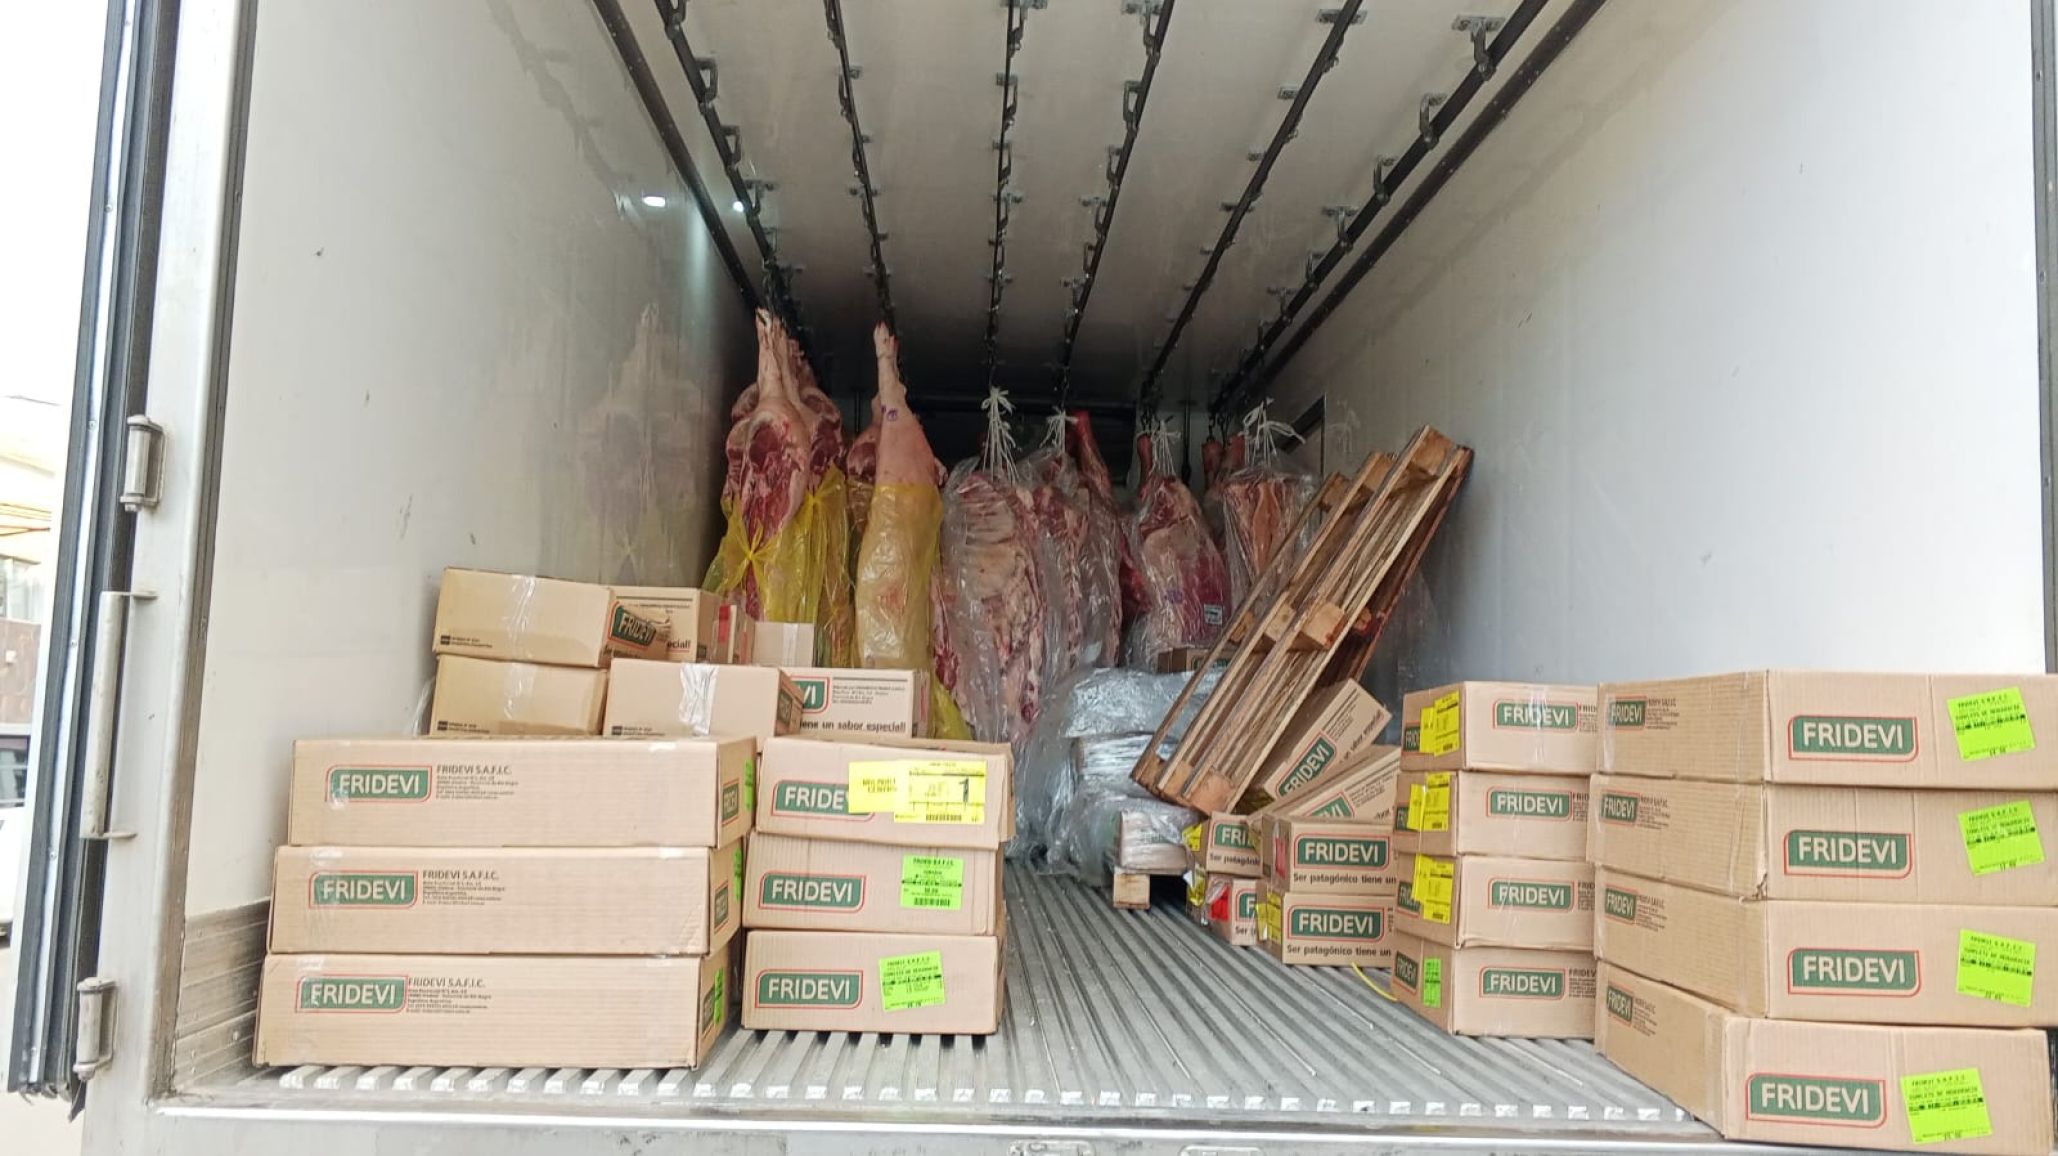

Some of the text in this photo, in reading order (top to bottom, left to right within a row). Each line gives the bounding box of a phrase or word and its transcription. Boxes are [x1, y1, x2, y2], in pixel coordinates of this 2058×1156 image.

[1503, 705, 1569, 727] FRIDEVI
[1611, 703, 1642, 724] FRIDEVI
[838, 720, 864, 731] sabor
[1803, 722, 1904, 750] FRIDEVI
[1284, 743, 1329, 794] FRIDEVI
[339, 774, 420, 796] FRIDEVI
[785, 786, 849, 811] FRIDE
[1497, 795, 1563, 814] FRIDEVI
[1603, 797, 1635, 819] FRIDEVI
[1304, 842, 1379, 863] FRIDEVI
[1799, 836, 1897, 864] FRIDEVI
[323, 879, 406, 900] FRIDEVI
[1293, 873, 1308, 883] Ser
[1310, 874, 1357, 886] patagónico
[1361, 875, 1382, 884] tiene
[772, 880, 852, 902] FRIDEVI
[1499, 886, 1565, 906] FRIDEVI
[1298, 912, 1373, 935] FRIDEVI
[1304, 945, 1352, 957] patagónico
[1356, 947, 1377, 956] tiene
[1803, 955, 1905, 984] FRIDEVI
[311, 983, 396, 1005] FRIDEVI
[769, 978, 850, 999] FRIDEVI
[1490, 974, 1556, 993] FRIDEVI
[1761, 1082, 1869, 1115] FRIDEVI
